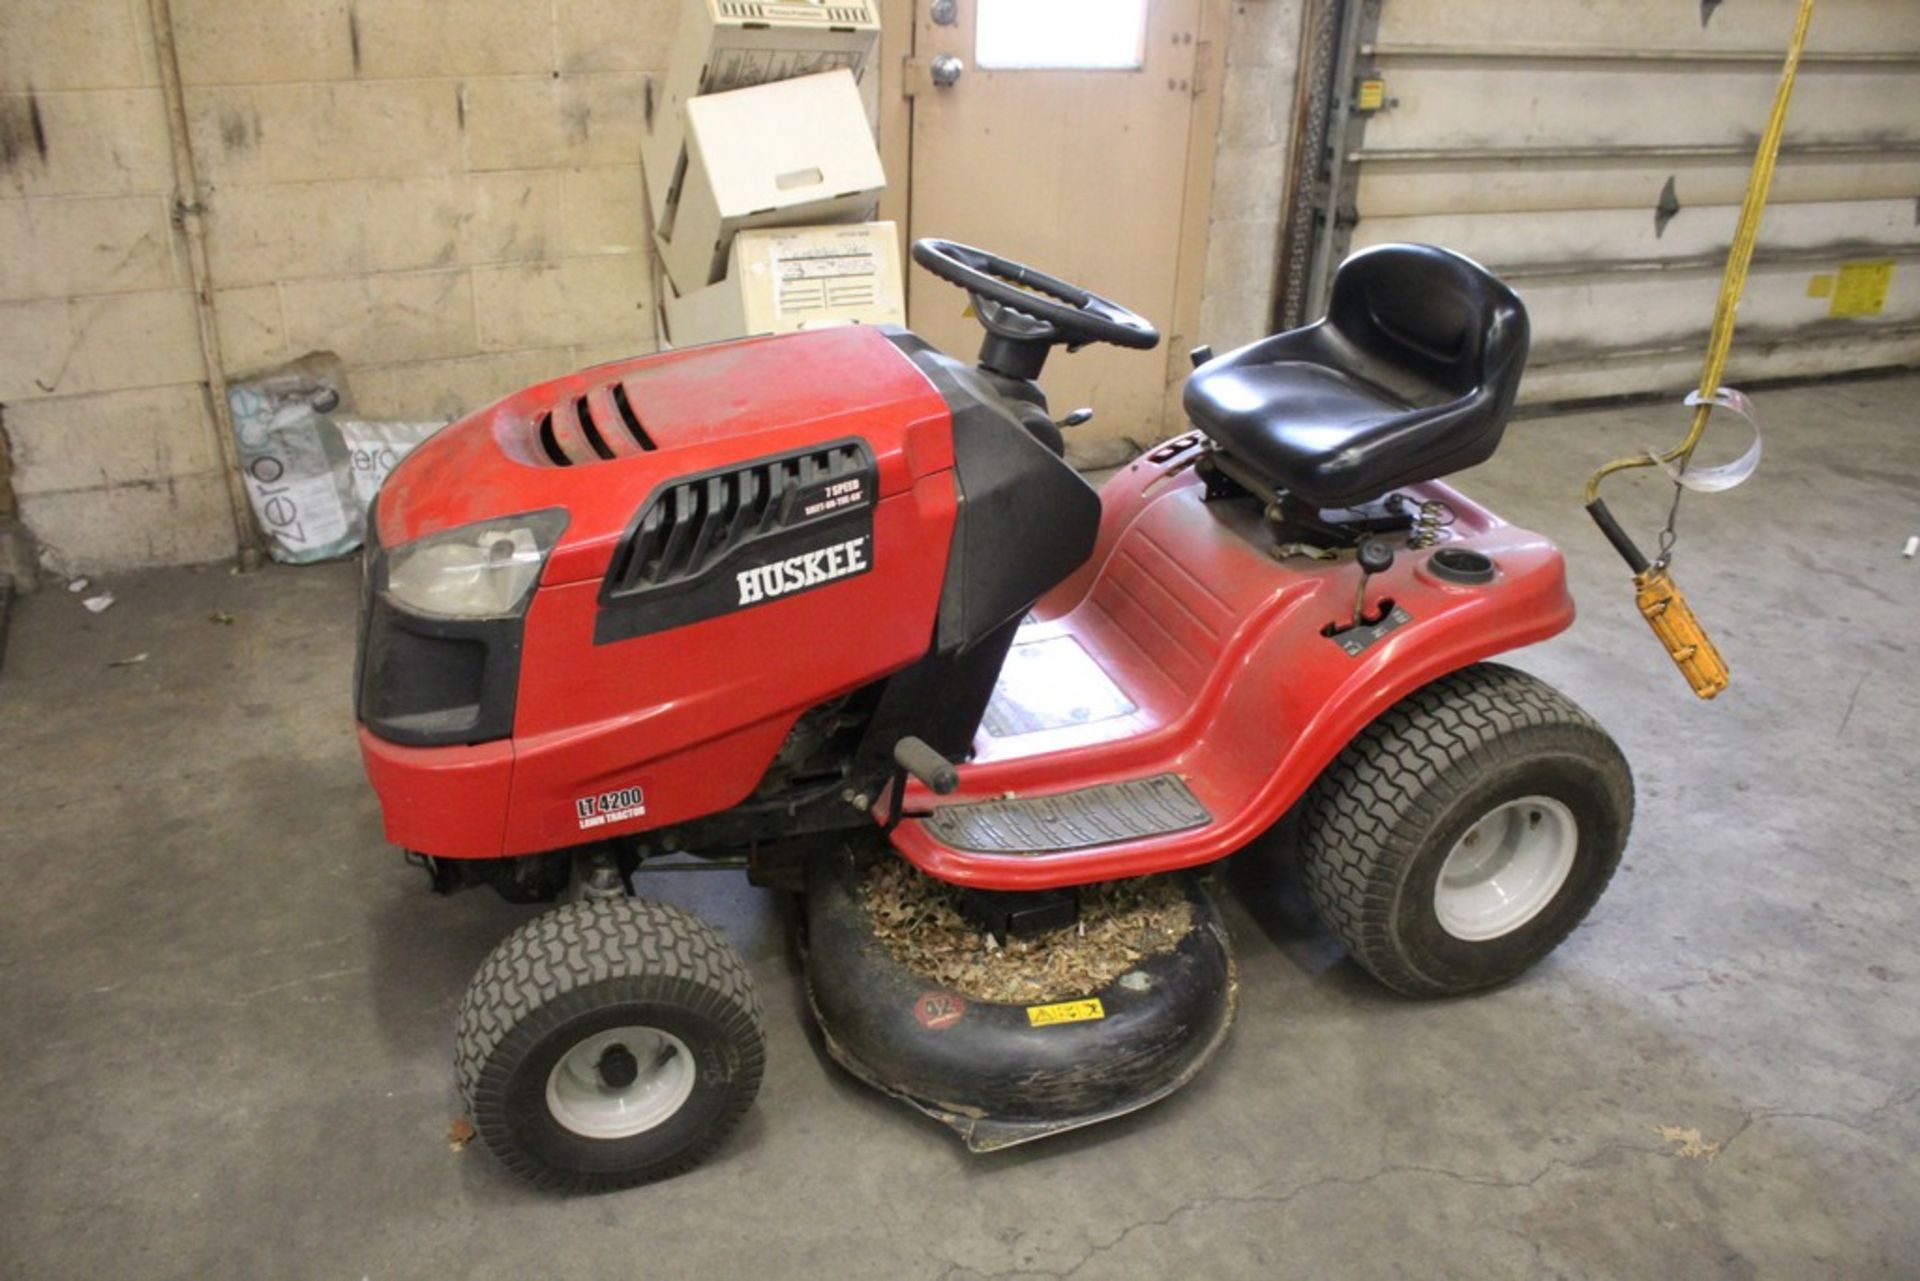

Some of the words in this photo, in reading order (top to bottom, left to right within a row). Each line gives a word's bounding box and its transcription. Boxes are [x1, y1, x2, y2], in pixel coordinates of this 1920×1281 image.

[351, 448, 398, 471] ero
[251, 456, 306, 543] zero
[825, 487, 831, 498] 7
[832, 479, 860, 496] SPEED
[736, 537, 867, 606] HUSKEE
[578, 797, 595, 817] LT
[599, 787, 642, 811] 4200
[604, 806, 646, 823] TRACTOR
